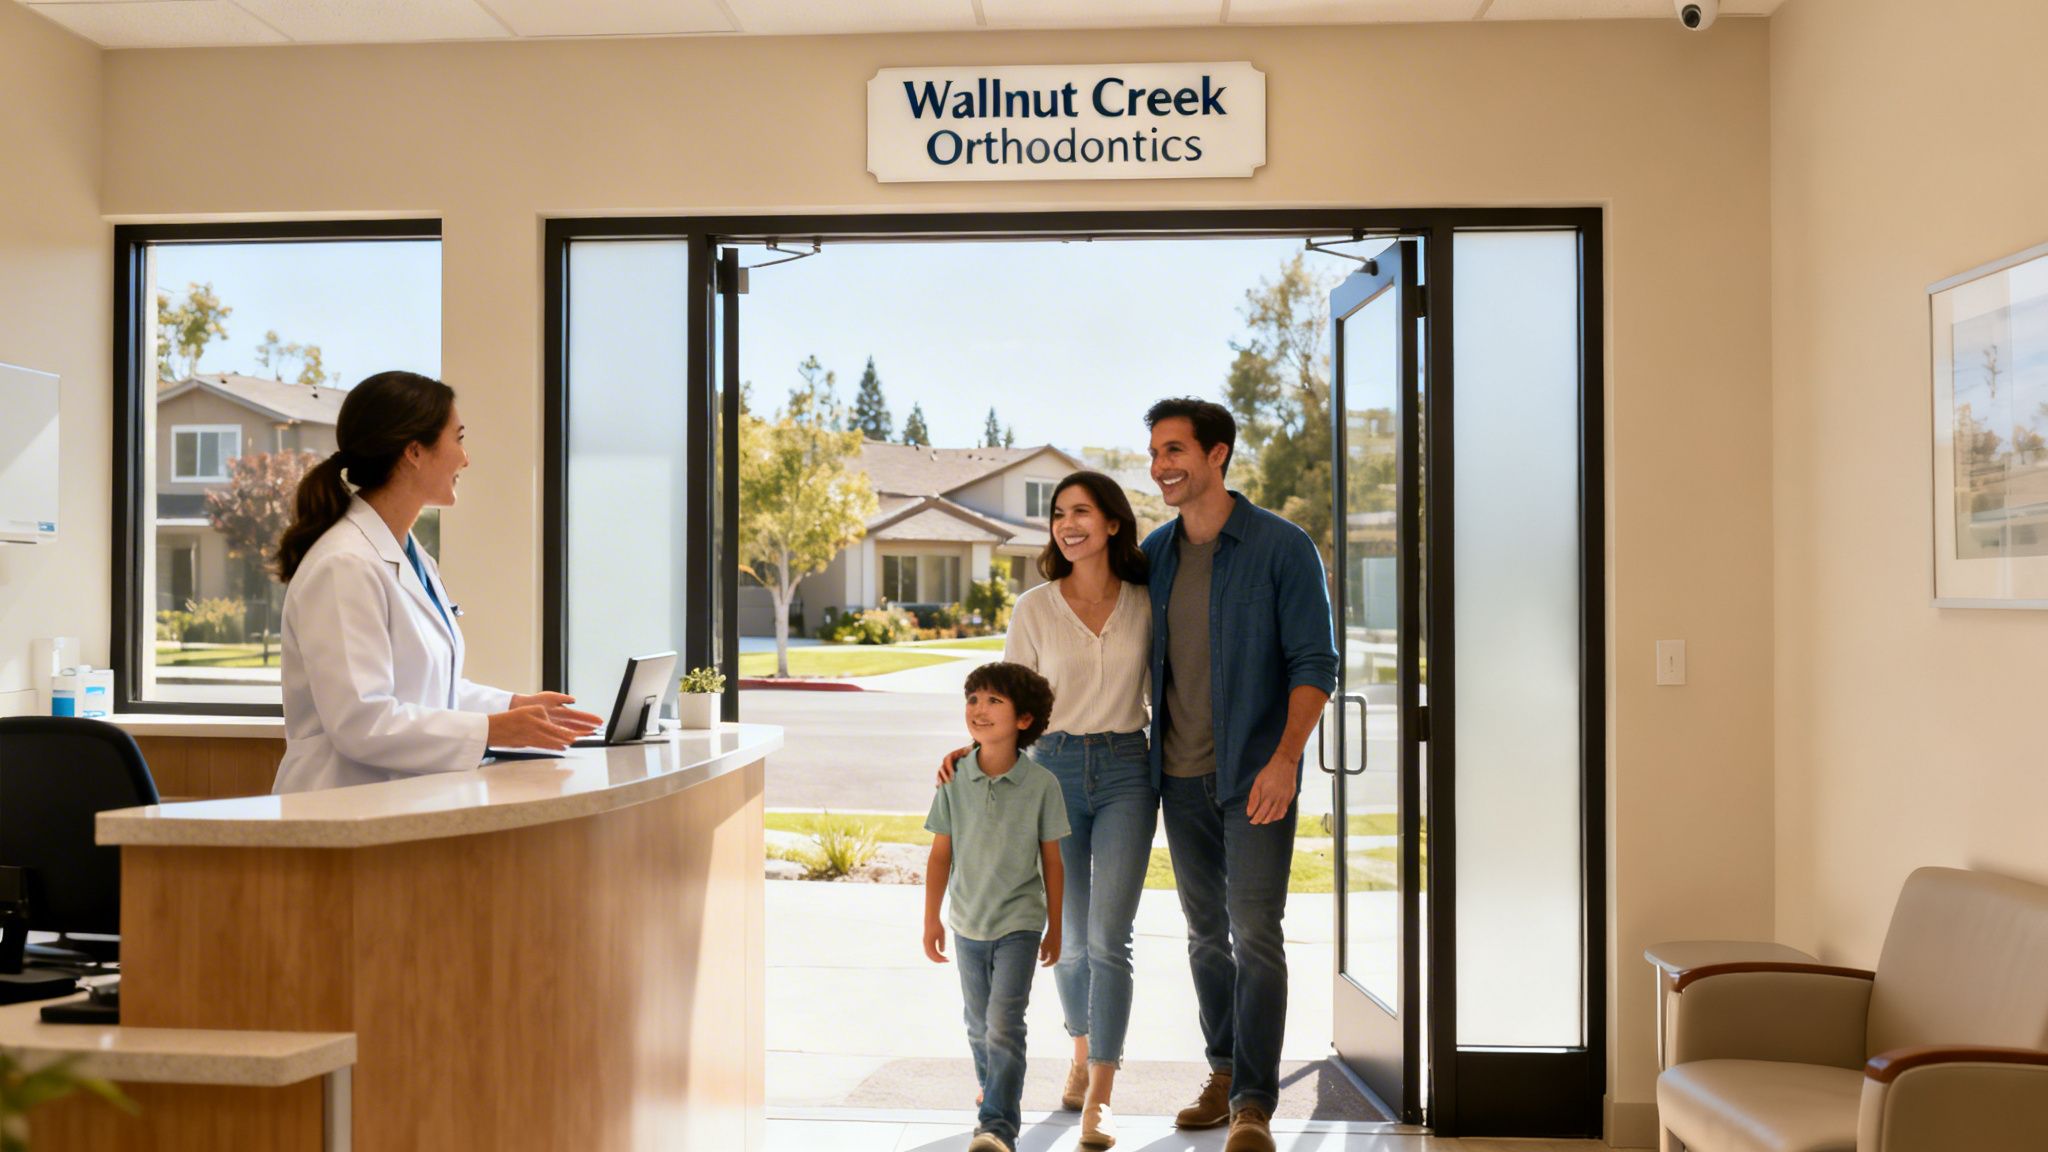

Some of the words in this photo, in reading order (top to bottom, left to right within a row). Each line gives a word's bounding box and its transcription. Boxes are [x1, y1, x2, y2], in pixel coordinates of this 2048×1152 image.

[902, 77, 1080, 119] Wallnut
[1091, 75, 1228, 117] Creek
[926, 126, 1203, 165] Orthodontics
